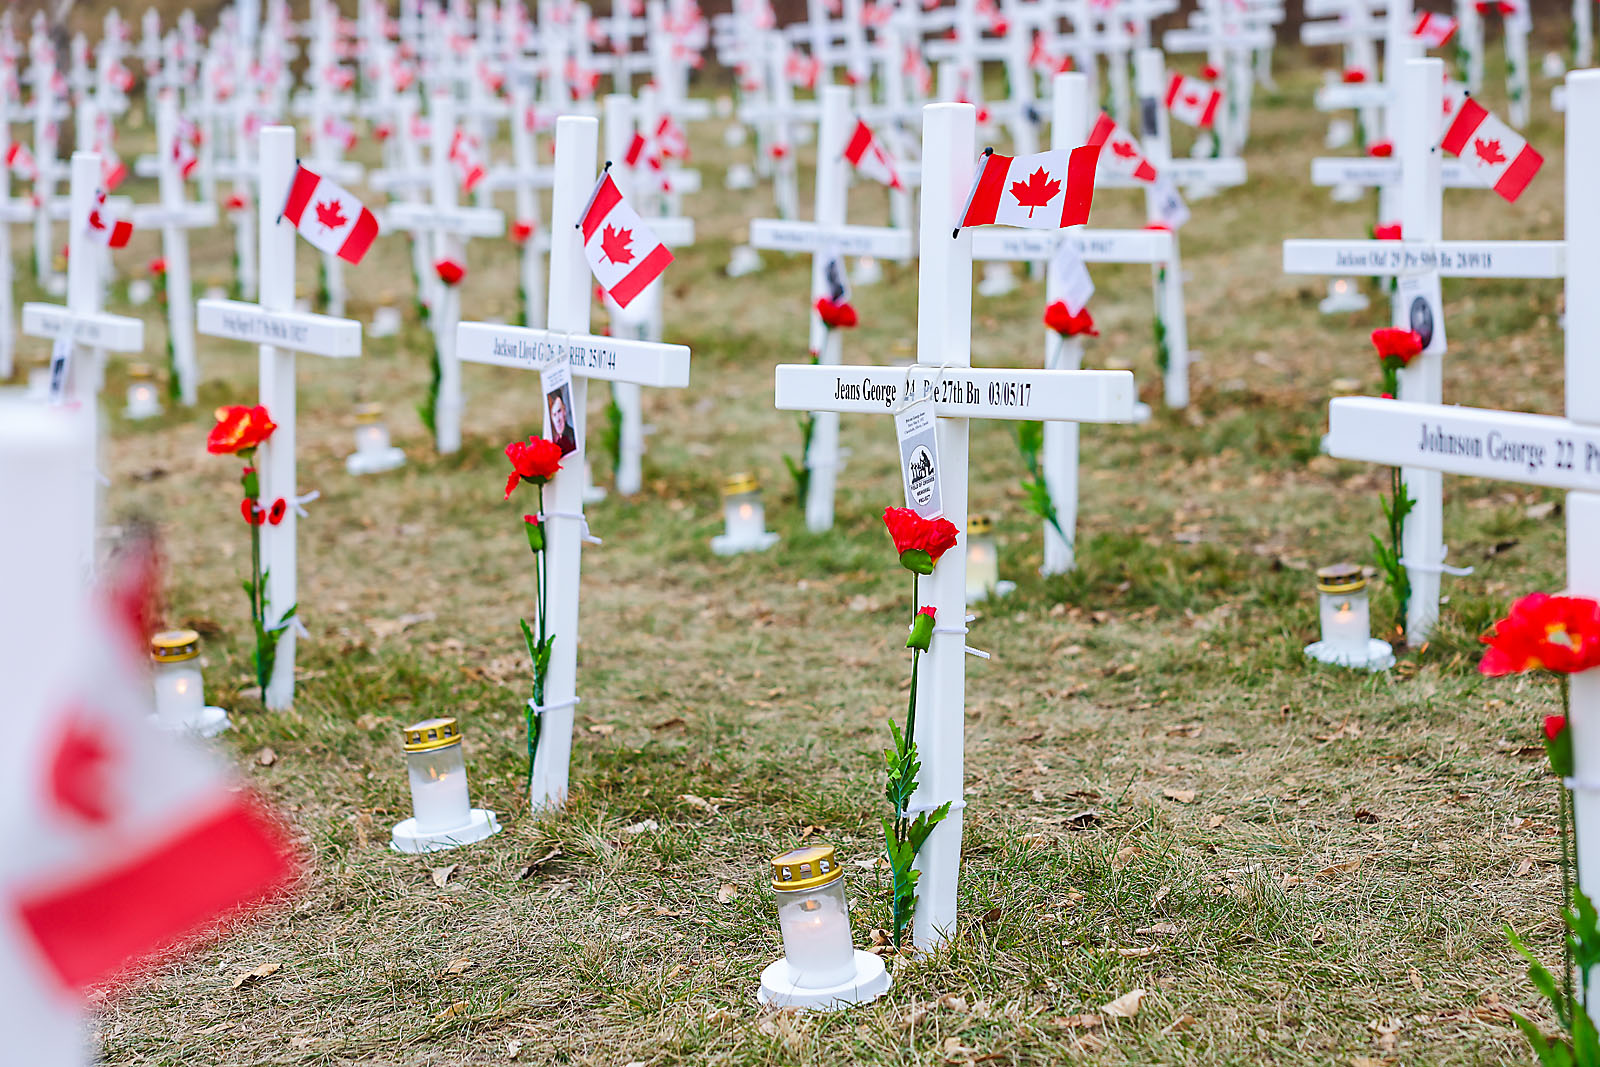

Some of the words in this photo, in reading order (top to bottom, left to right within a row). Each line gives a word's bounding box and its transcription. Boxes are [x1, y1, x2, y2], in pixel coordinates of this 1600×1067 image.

[834, 377, 861, 400] Jeans
[862, 378, 897, 408] George
[941, 380, 963, 404] 27th
[966, 381, 981, 405] Bn
[988, 382, 1031, 407] 03/05/17
[1418, 423, 1483, 459] Johnson
[1487, 431, 1546, 474] George
[1555, 439, 1575, 470] 22
